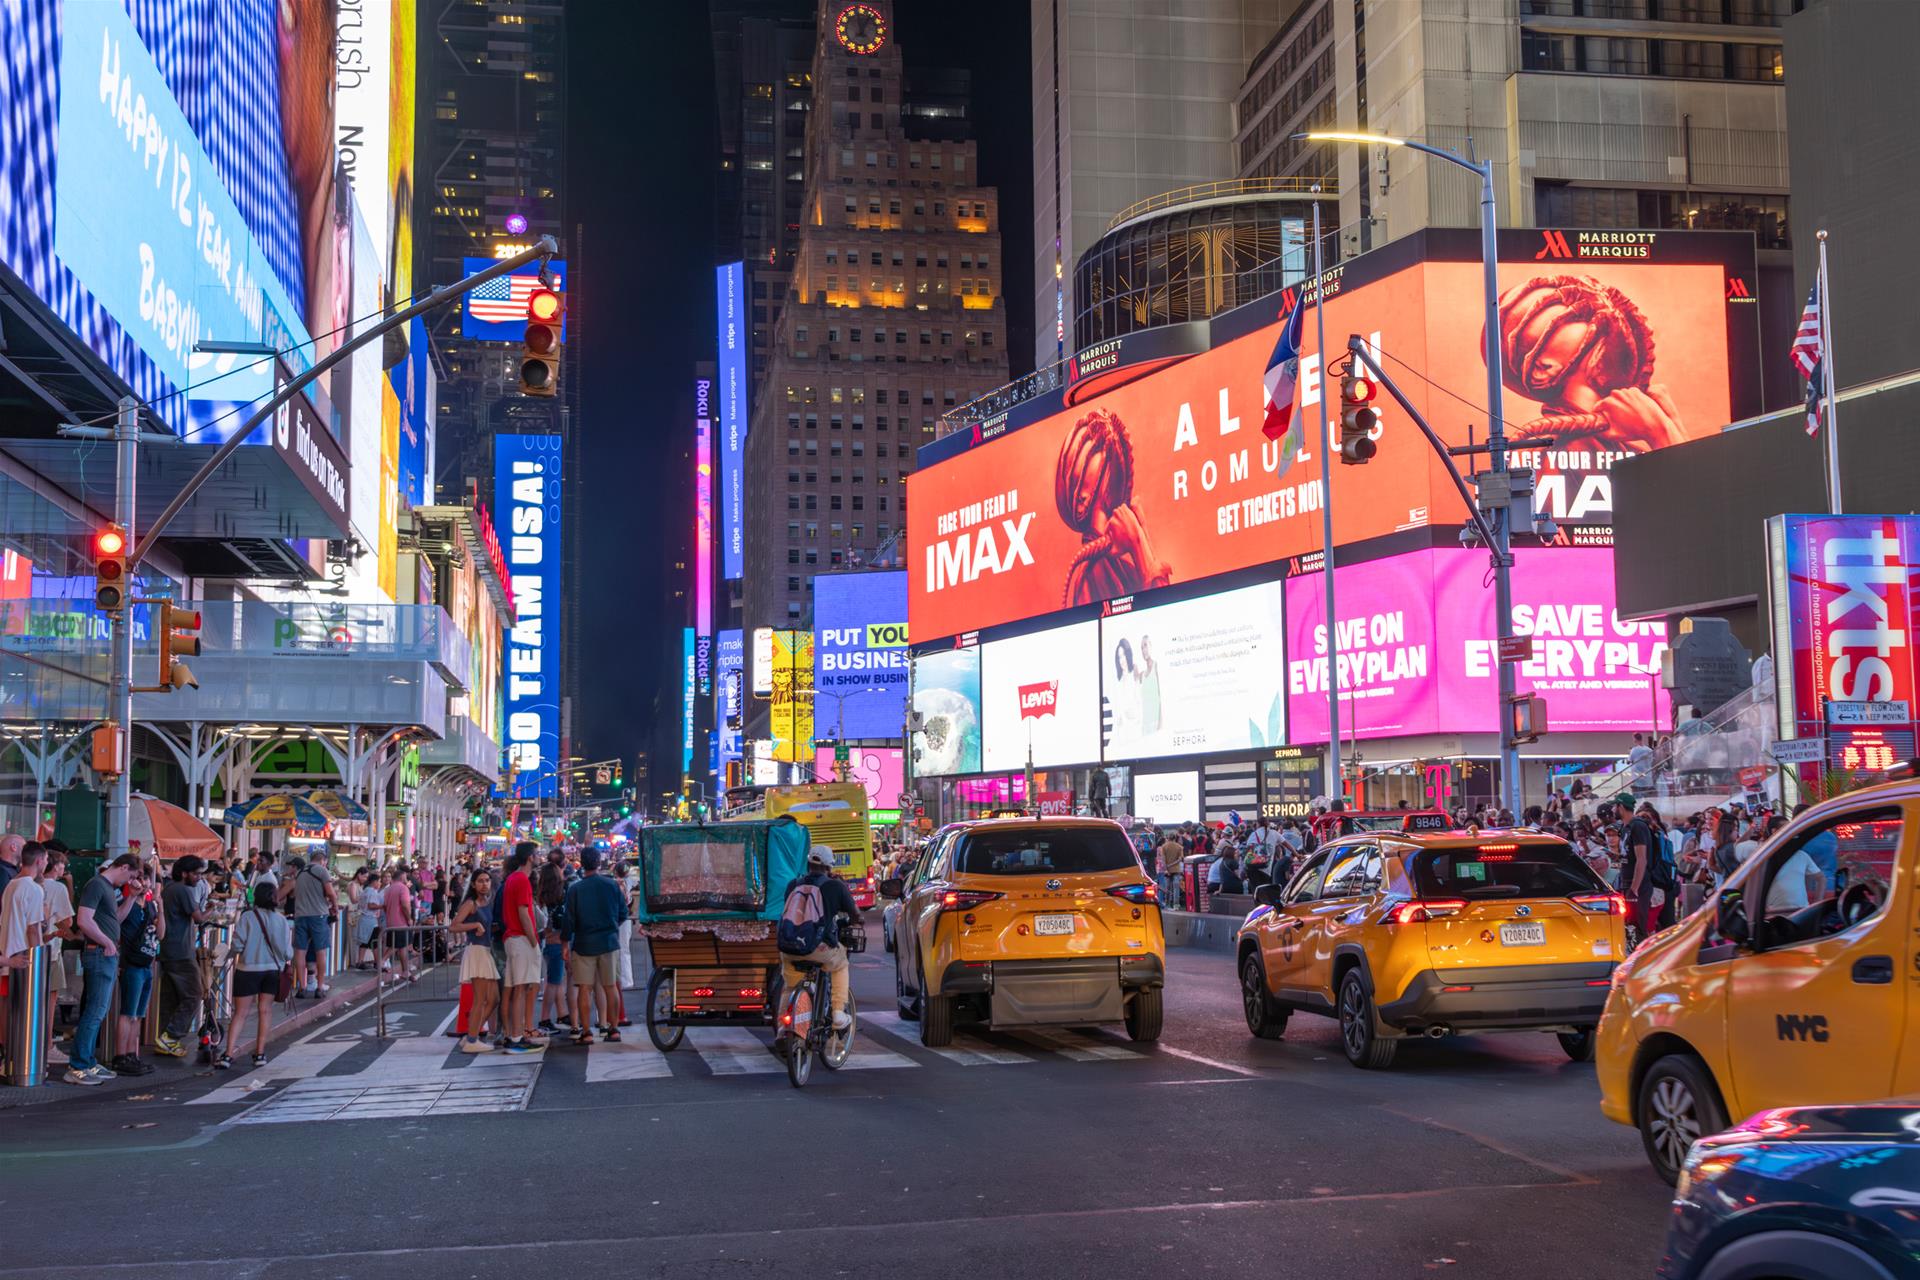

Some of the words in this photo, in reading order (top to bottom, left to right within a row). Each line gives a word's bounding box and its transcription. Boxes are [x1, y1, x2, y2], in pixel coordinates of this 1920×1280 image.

[100, 26, 169, 189] HAPPY
[171, 139, 192, 228] 12
[197, 192, 231, 296] YEAR
[1579, 232, 1656, 243] MARRIOTT
[1580, 246, 1648, 257] MARQUIS
[1301, 266, 1345, 292] MARIOTT
[727, 322, 735, 350] stripe
[1080, 339, 1122, 363] MARRIOTT
[1080, 354, 1117, 375] MARQUIS
[983, 412, 1009, 429] MARRIOTT
[983, 423, 1006, 439] MARQUIS
[730, 424, 739, 452] stripe
[1549, 451, 1591, 470] YOUR
[327, 456, 346, 512] TikTok
[511, 461, 544, 564] USA!
[938, 511, 958, 536] FACE
[959, 502, 983, 528] YOUR
[983, 493, 1006, 520] FEAR
[1007, 489, 1018, 512] IN
[1217, 502, 1240, 536] GET
[1242, 486, 1296, 530] TICKETS
[732, 527, 740, 554] stripe
[926, 511, 1036, 593] IMAX
[1810, 545, 1819, 579] service
[1812, 580, 1819, 595] of
[1112, 596, 1134, 607] MARRIOTT
[1112, 604, 1132, 614] MARQUIS
[1812, 595, 1822, 627] theatre
[1370, 611, 1404, 646] ON
[1511, 604, 1604, 637] SAVE
[1824, 530, 1906, 702] tkts
[509, 575, 542, 701] TEAM
[822, 628, 862, 647] PUT
[1366, 644, 1427, 683] PLAN
[1814, 629, 1825, 687] development
[822, 675, 834, 686] IN
[836, 673, 871, 685] SHOW
[1837, 704, 1870, 712] PEDESTRIA
[1888, 703, 1905, 712] ZONE
[508, 712, 541, 772] GO
[1172, 735, 1207, 747] SEPHORA
[1275, 748, 1302, 758] SEPHORA
[1041, 799, 1067, 815] evi's
[1150, 793, 1183, 802] VORNADO
[1262, 803, 1310, 818] SEPHORA
[1416, 816, 1442, 829] 9B46
[1776, 1014, 1829, 1042] NYC
